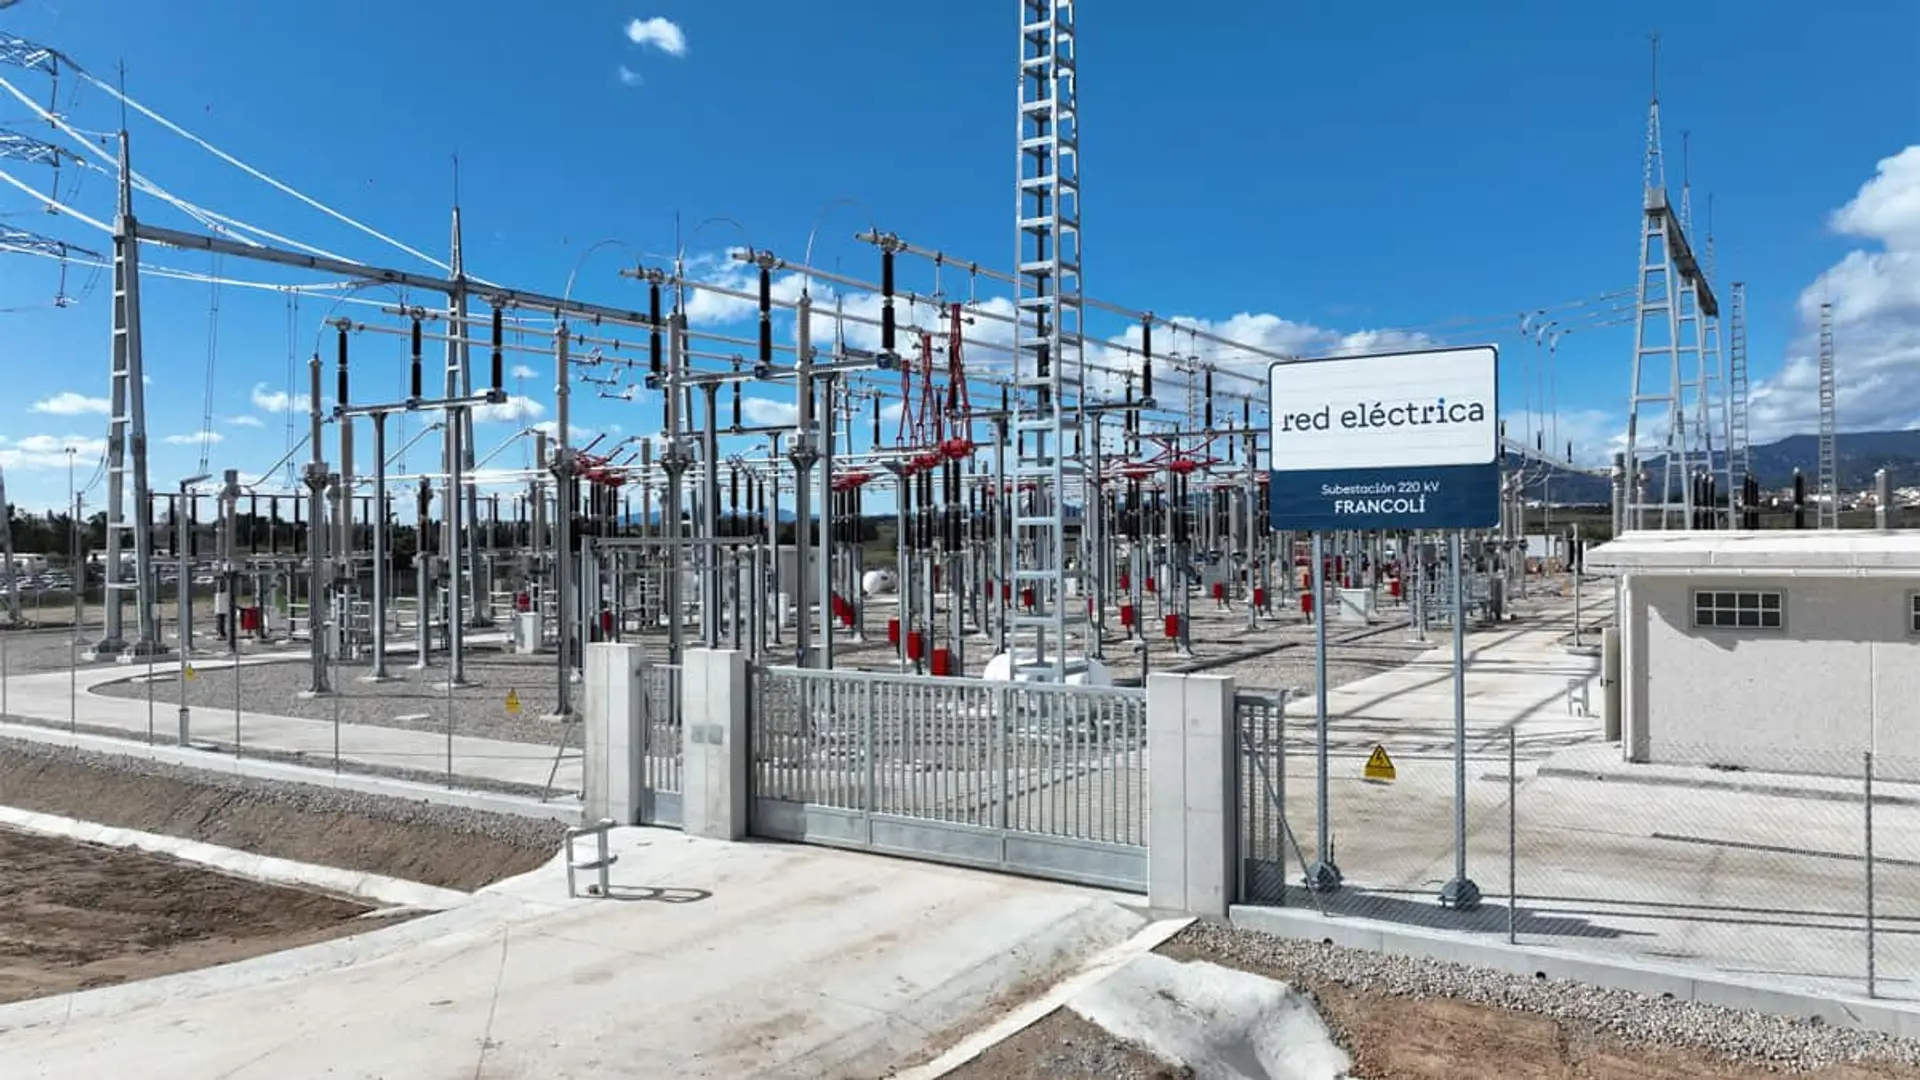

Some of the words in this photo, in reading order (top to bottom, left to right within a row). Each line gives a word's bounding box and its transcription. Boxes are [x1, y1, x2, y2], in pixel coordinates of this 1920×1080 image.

[1281, 405, 1330, 432] red
[1341, 397, 1485, 429] eléctrica
[1321, 483, 1396, 495] Subestación
[1397, 481, 1421, 493] 220
[1423, 481, 1440, 493] kV
[1334, 494, 1426, 514] FRANCOLÍ
